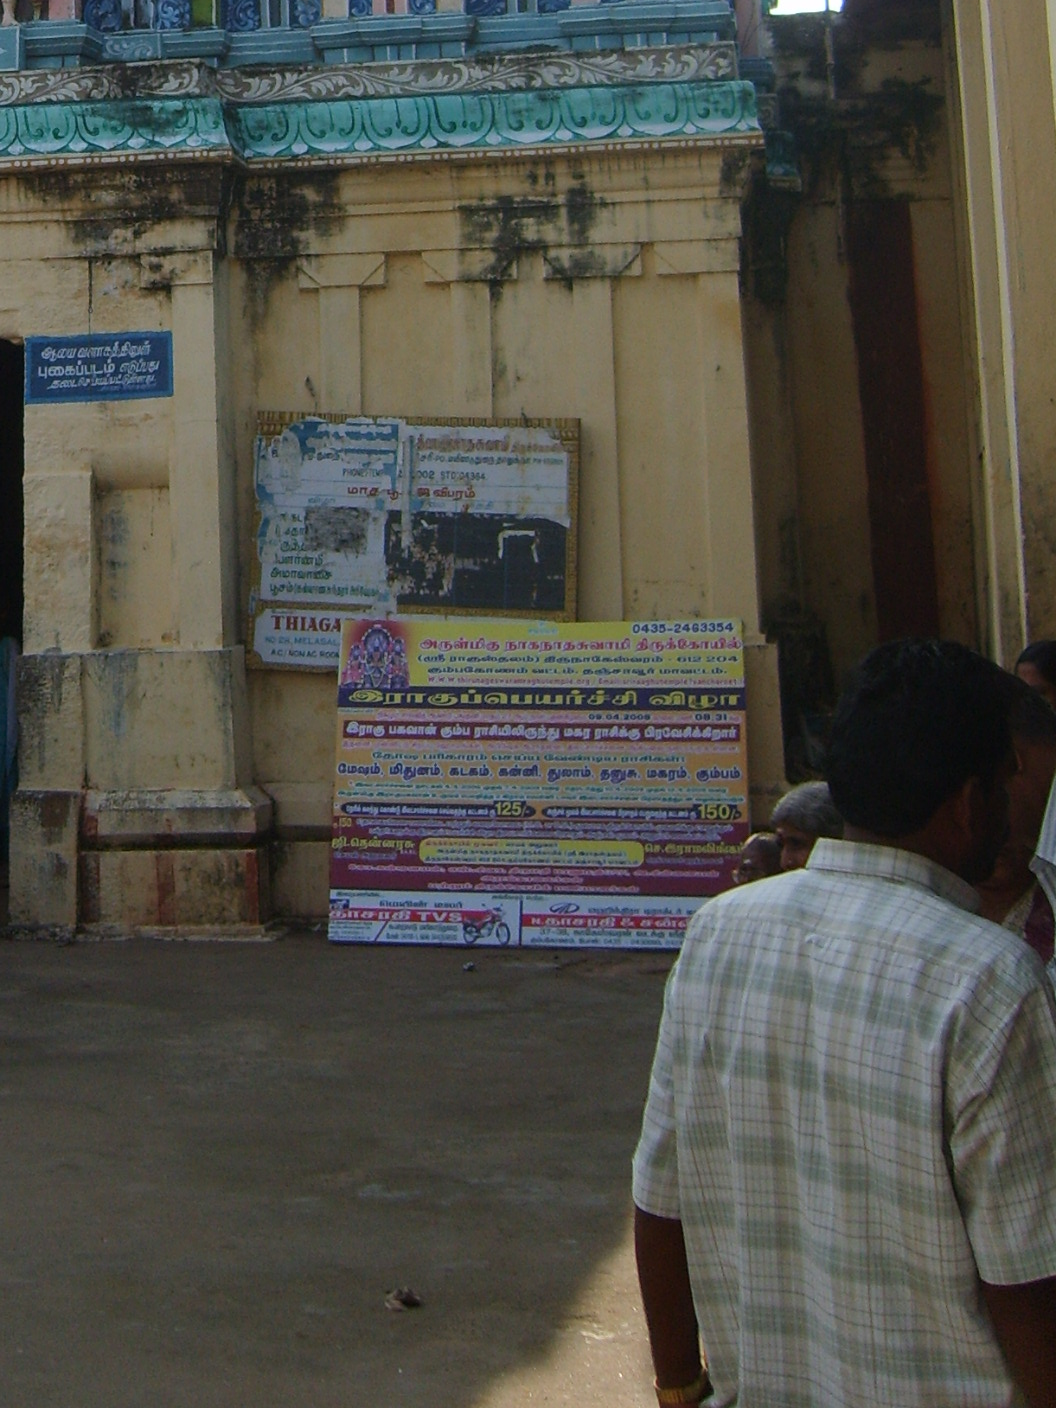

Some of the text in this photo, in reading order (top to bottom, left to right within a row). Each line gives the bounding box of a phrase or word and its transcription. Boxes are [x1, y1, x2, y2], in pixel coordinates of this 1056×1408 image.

[38, 359, 116, 379] புகைப்படம்
[271, 615, 341, 633] THIAGA
[631, 621, 735, 635] 0435-2463354
[419, 637, 743, 653] அருள்மிகு நாகநாதசுவாமி திருக்கோயில்
[677, 656, 702, 664] 612
[706, 656, 739, 664] 204
[427, 666, 529, 675] கும்பகோணம்
[348, 689, 741, 709] இராகுப்பெயர்ச்சி விழா
[346, 721, 385, 737] இராகு
[388, 722, 437, 737] பகவான்
[440, 722, 470, 738] கும்ப
[473, 723, 561, 740] ராசியிலிருந்து
[563, 726, 591, 739] மகர
[593, 725, 642, 741] ராசிக்கு
[696, 767, 741, 783] கும்பம்
[417, 911, 463, 922] TVS
